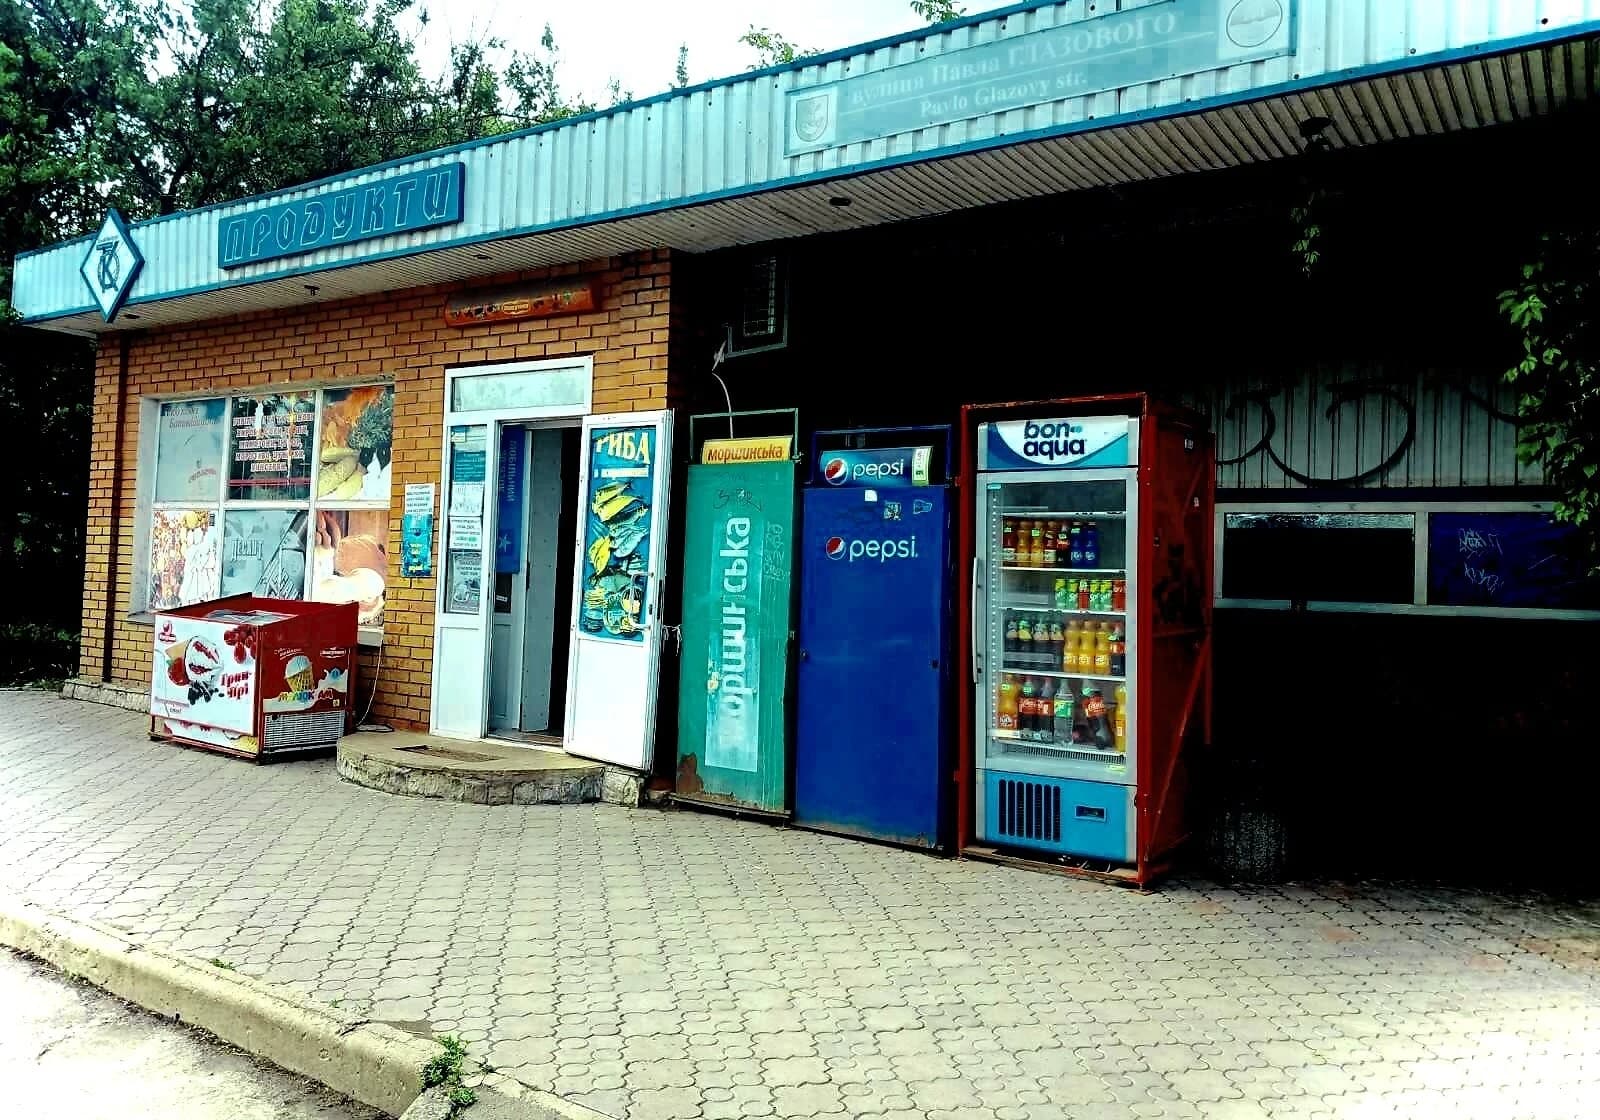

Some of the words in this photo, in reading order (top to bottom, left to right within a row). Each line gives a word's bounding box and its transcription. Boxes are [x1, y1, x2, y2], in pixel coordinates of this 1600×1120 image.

[852, 75, 924, 107] вулиця
[932, 58, 999, 85] Павла
[1007, 13, 1177, 70] ГЛАЗОВОГО
[920, 95, 968, 118] Pavlo
[974, 74, 1051, 106] Glazovy
[1056, 70, 1088, 90] str.
[223, 170, 452, 262] ПРОДУКТИ
[852, 458, 905, 481] pepsi
[1023, 438, 1086, 461] aqua
[849, 535, 918, 563] pepsi
[719, 515, 758, 719] оршинська
